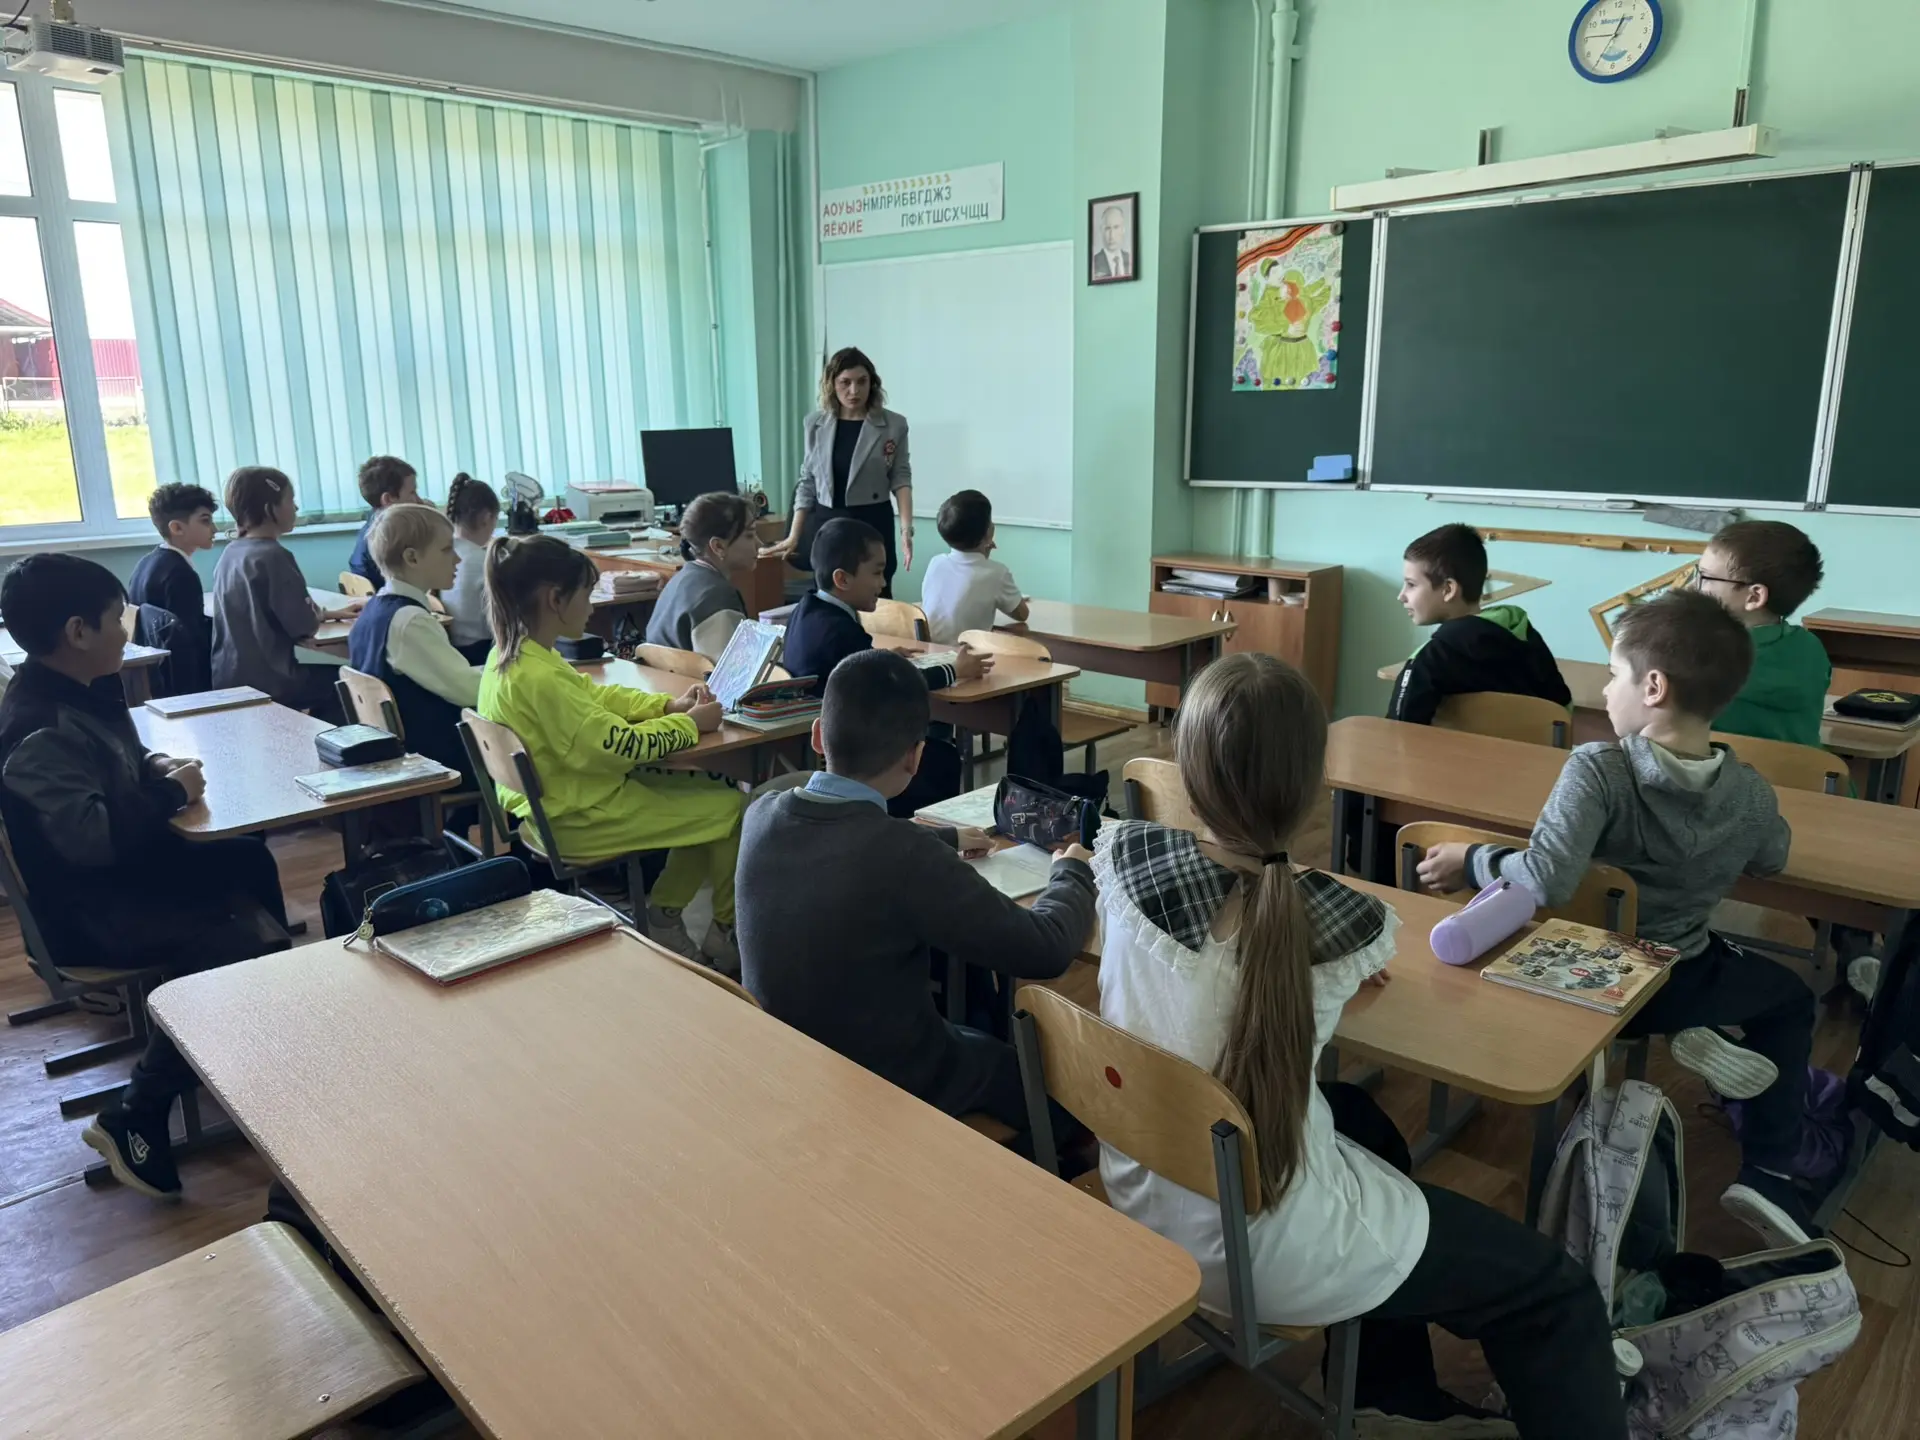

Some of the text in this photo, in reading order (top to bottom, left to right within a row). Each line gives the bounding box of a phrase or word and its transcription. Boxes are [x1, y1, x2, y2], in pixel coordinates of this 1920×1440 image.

[1599, 9, 1606, 17] 11
[1640, 12, 1645, 20] 2
[1626, 54, 1632, 62] 5
[603, 725, 643, 760] STAY
